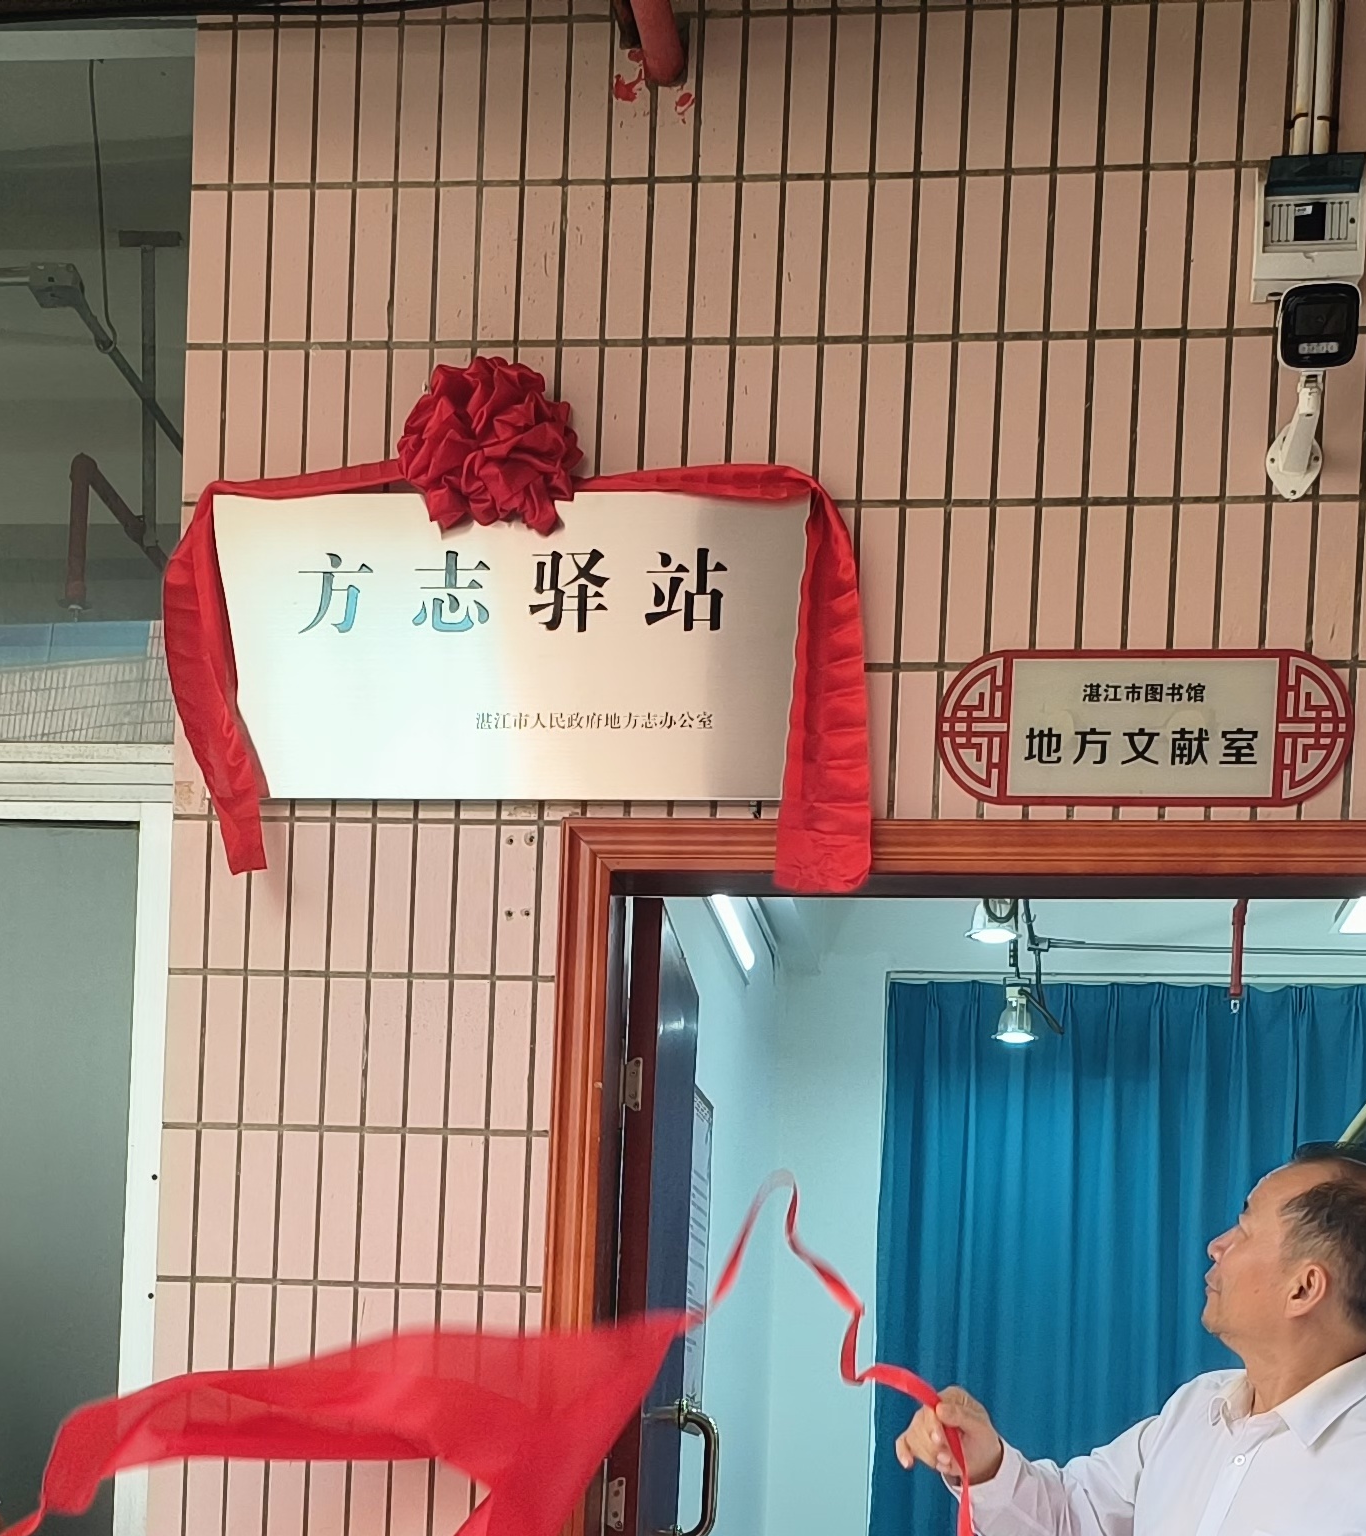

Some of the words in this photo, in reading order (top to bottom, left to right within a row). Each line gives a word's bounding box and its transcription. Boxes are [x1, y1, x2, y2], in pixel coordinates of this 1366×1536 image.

[298, 548, 728, 633] 方志驿站
[1082, 682, 1206, 703] 湛江市图书馆
[476, 711, 714, 730] 湛江市人民政府地方志办公室
[1024, 727, 1260, 766] 地方文献室
